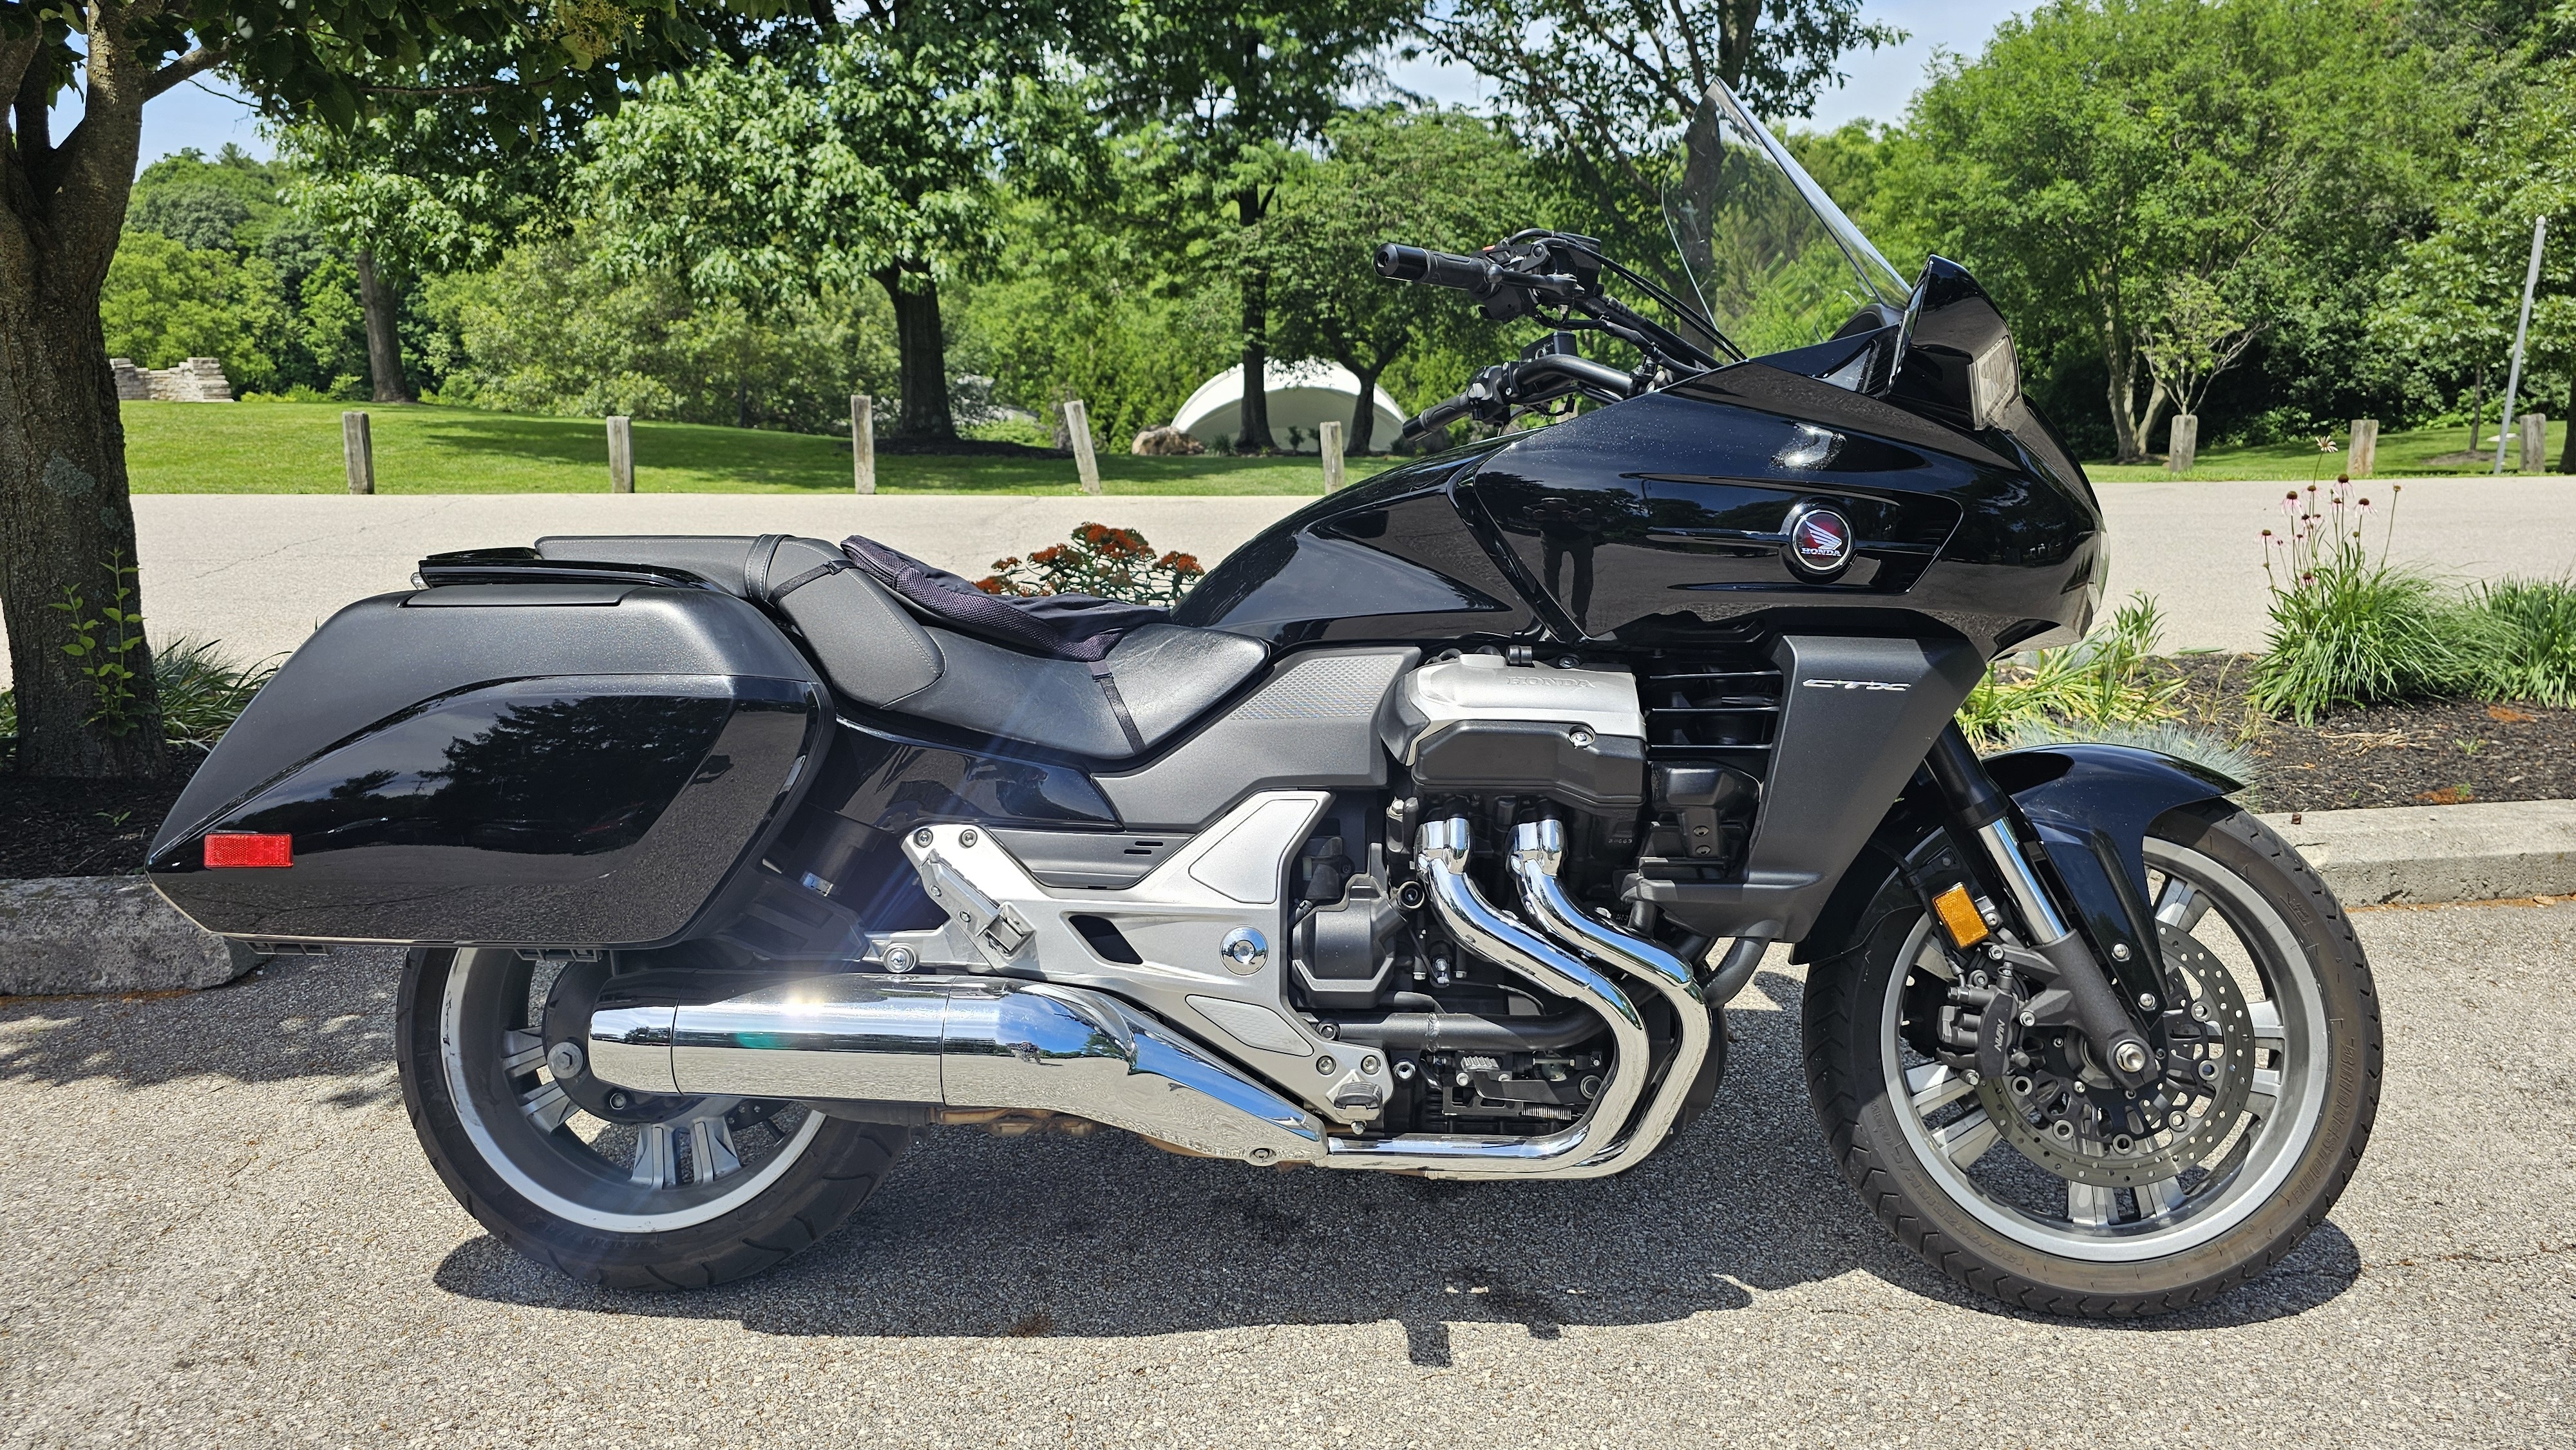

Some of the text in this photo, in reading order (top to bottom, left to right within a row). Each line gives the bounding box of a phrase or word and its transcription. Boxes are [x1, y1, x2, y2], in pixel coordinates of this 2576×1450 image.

[1801, 547, 1841, 557] HONDA
[1506, 676, 1596, 688] HONDA
[1803, 679, 1911, 692] CTX
[2292, 1037, 2355, 1204] BRIDGESTONE
